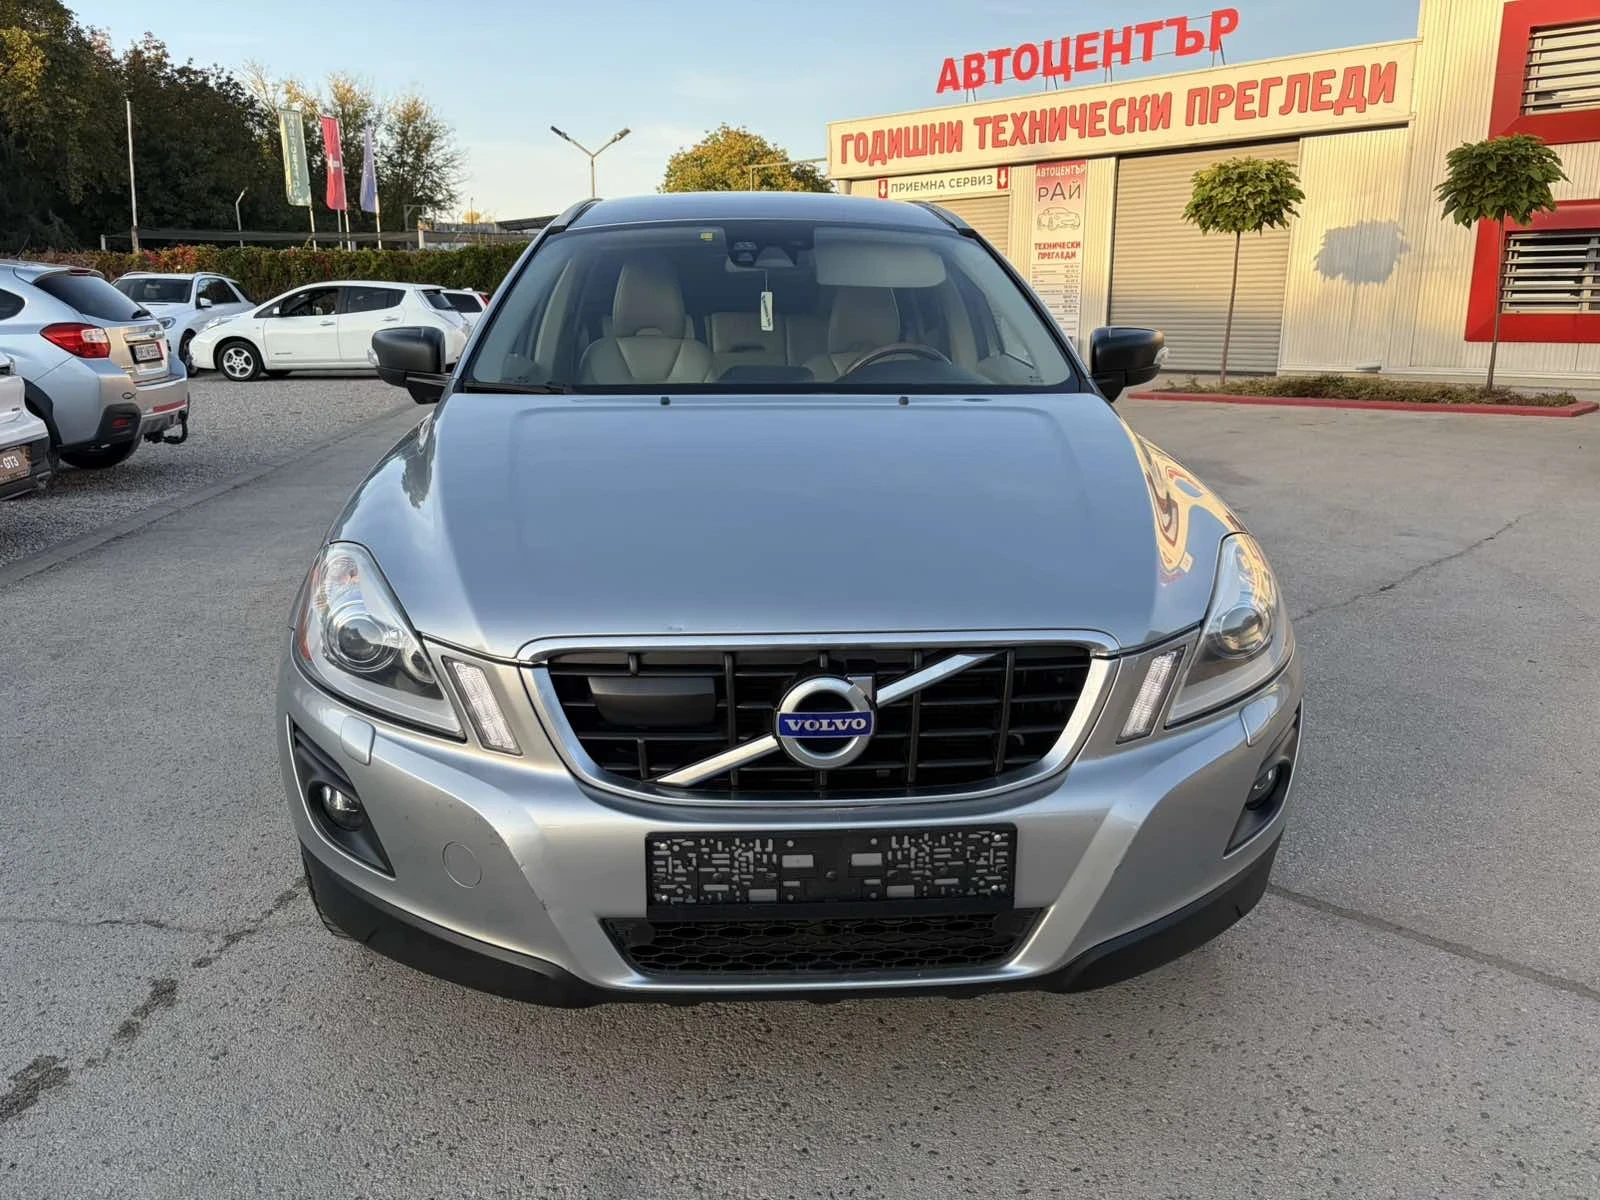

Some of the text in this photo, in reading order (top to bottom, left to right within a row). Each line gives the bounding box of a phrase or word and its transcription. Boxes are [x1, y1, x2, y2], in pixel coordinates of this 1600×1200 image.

[936, 8, 1239, 93] АВТОЦЕНТЪР
[841, 61, 1398, 166] ГОДИШНИ ТЕХНИЧЕСКИ ПРЕГЛЕДИ
[1036, 164, 1086, 177] АВТОЦЕНТЪР
[890, 174, 993, 193] ПРИЕМНА СЕРВИЗ
[1034, 240, 1081, 251] ТЕХНИЧЕСКИ
[1037, 250, 1077, 261] ПРЕГЛЕДИ
[784, 718, 867, 731] VOLVO
